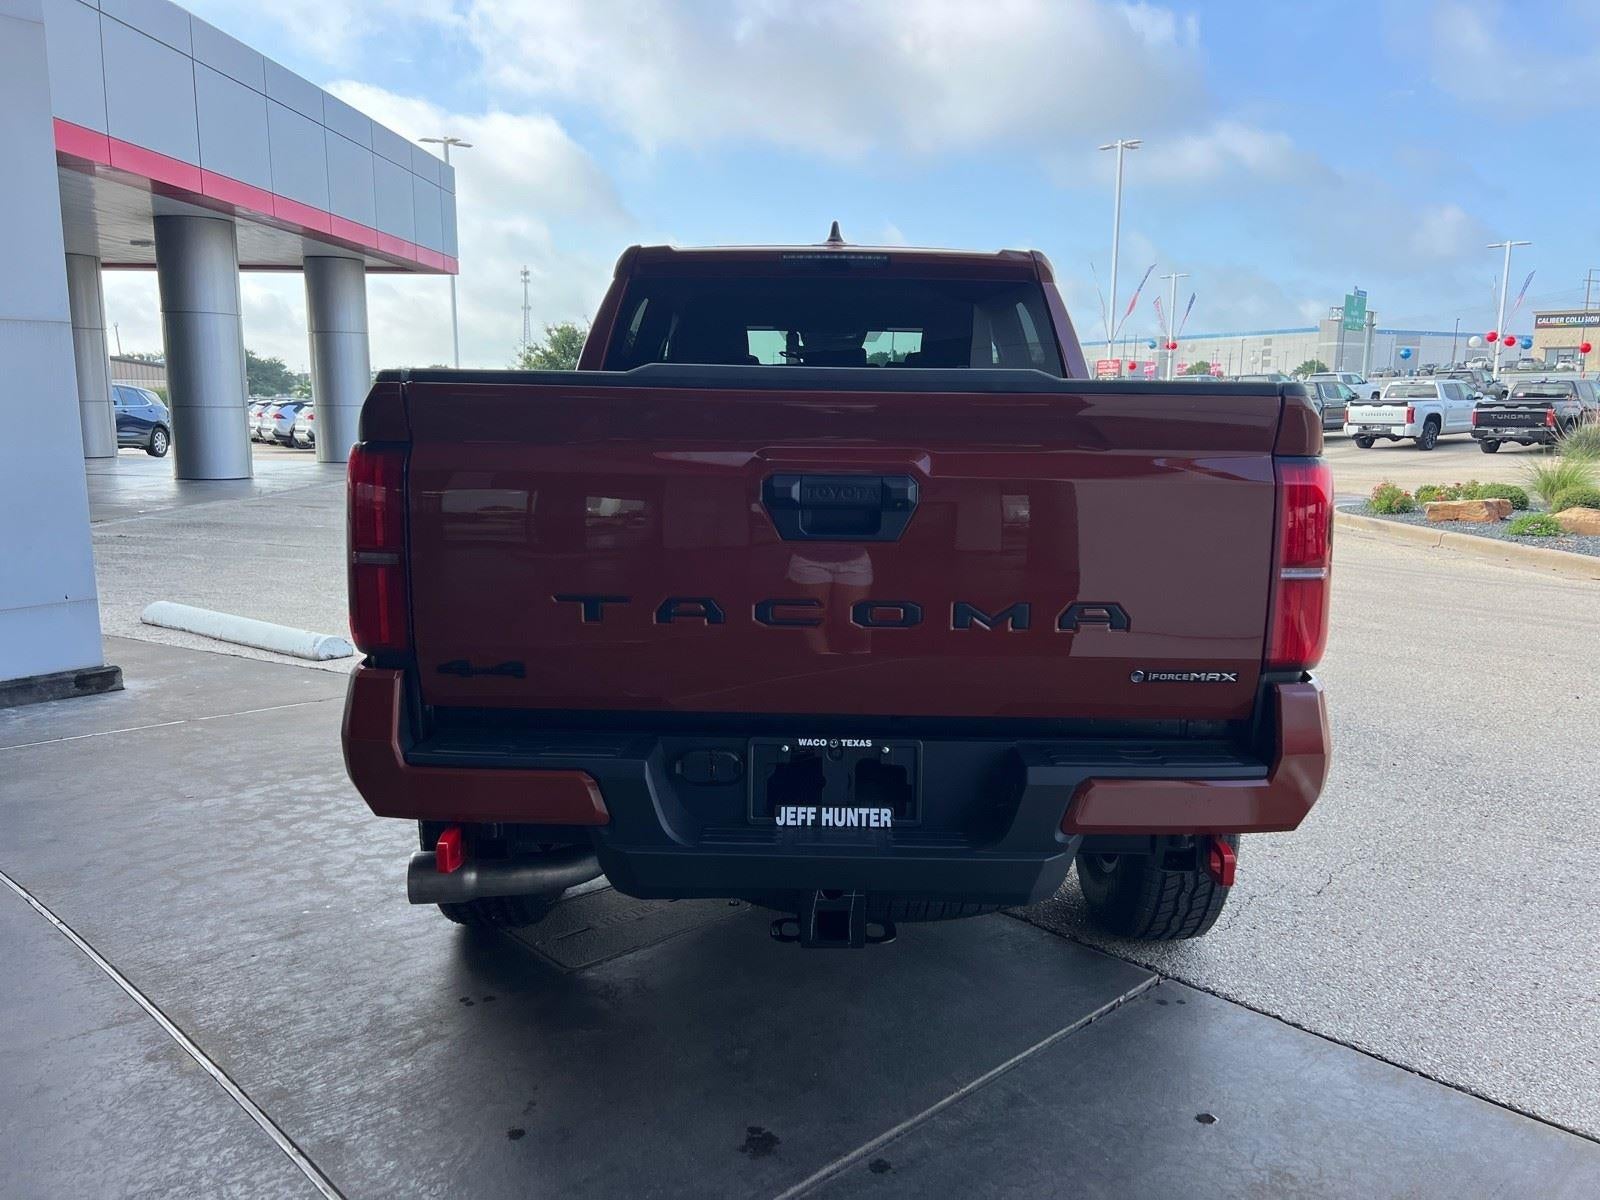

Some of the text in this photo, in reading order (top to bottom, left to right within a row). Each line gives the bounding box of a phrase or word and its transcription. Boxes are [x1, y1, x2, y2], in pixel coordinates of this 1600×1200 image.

[806, 486, 878, 500] TOYOTA
[551, 594, 1132, 632] TACOMA
[798, 738, 873, 747] WACO TEXAS
[775, 806, 892, 828] JEFF HUNTER
